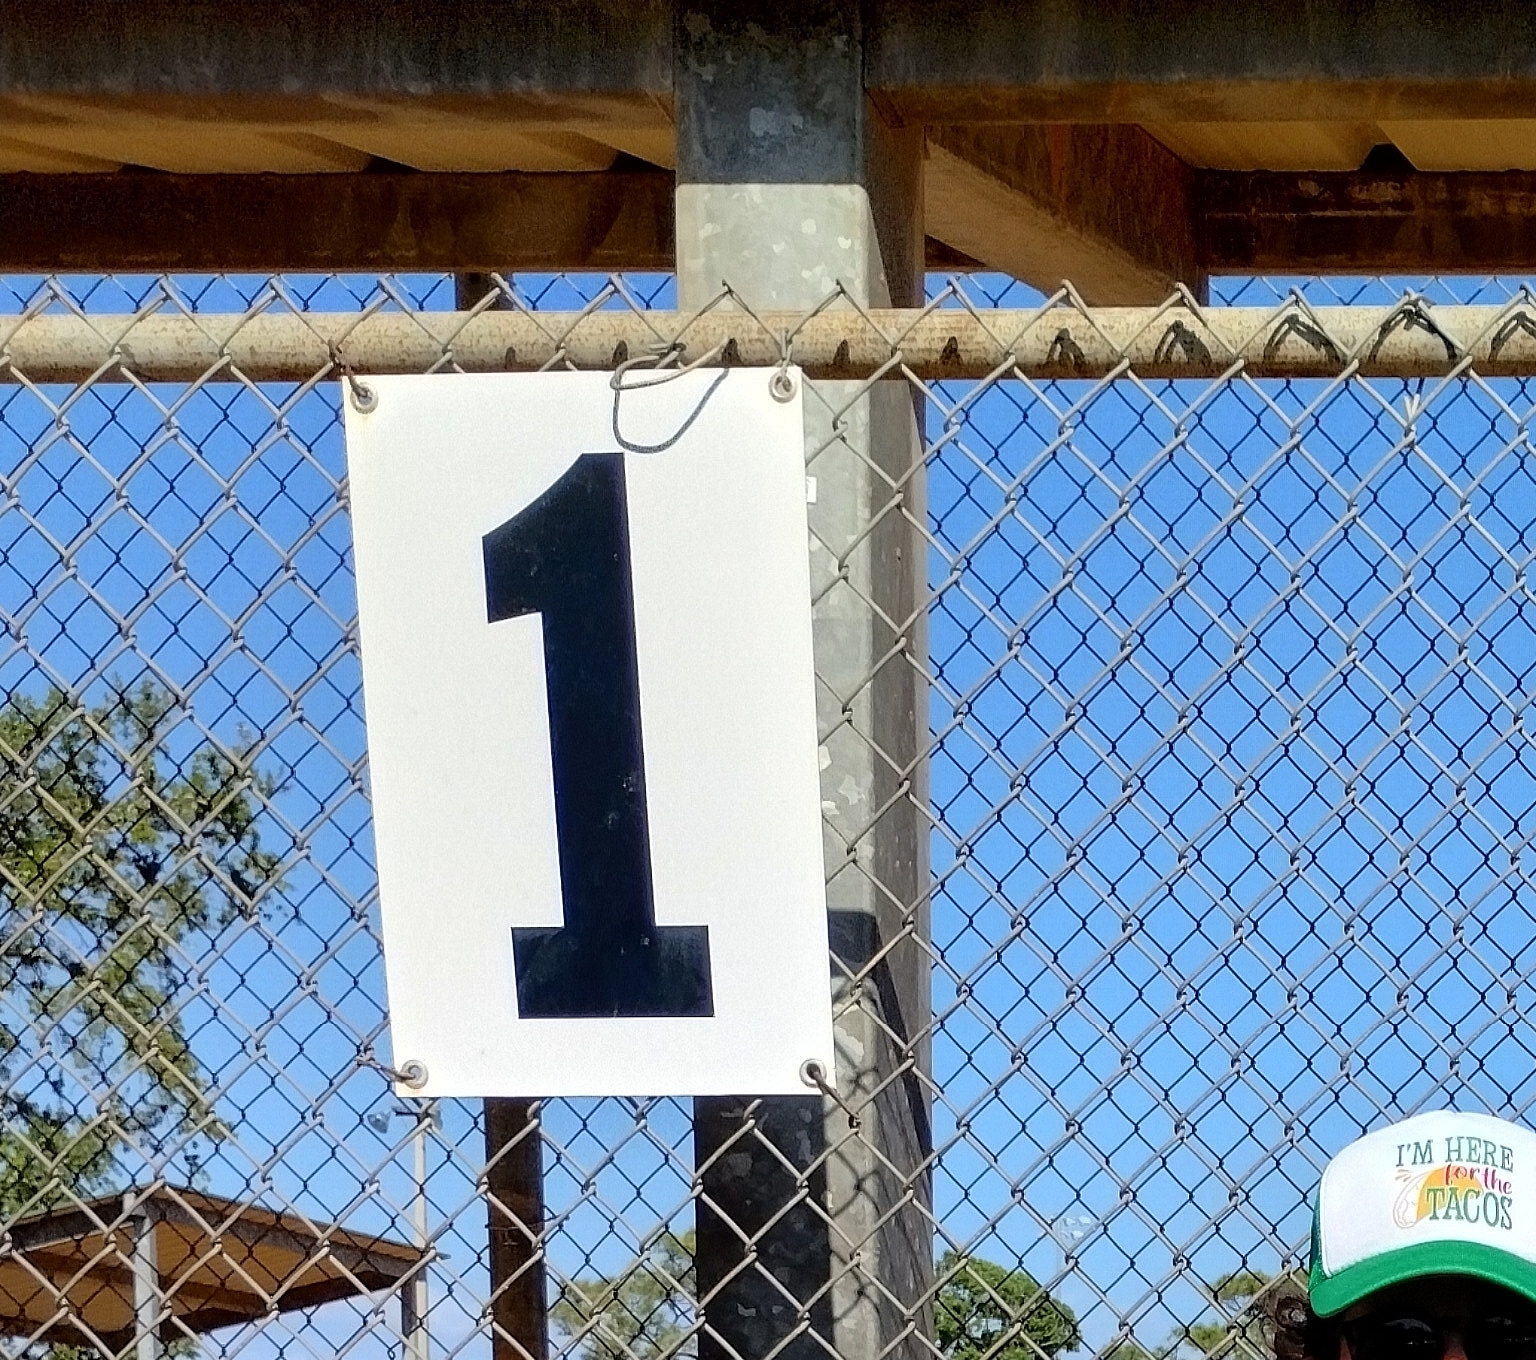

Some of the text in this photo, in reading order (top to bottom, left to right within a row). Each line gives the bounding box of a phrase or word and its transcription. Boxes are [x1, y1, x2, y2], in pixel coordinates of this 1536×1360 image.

[482, 452, 715, 1018] 1
[1395, 1136, 1514, 1173] I'M HERE
[1445, 1163, 1513, 1195] for the
[1426, 1186, 1513, 1231] TACOS
